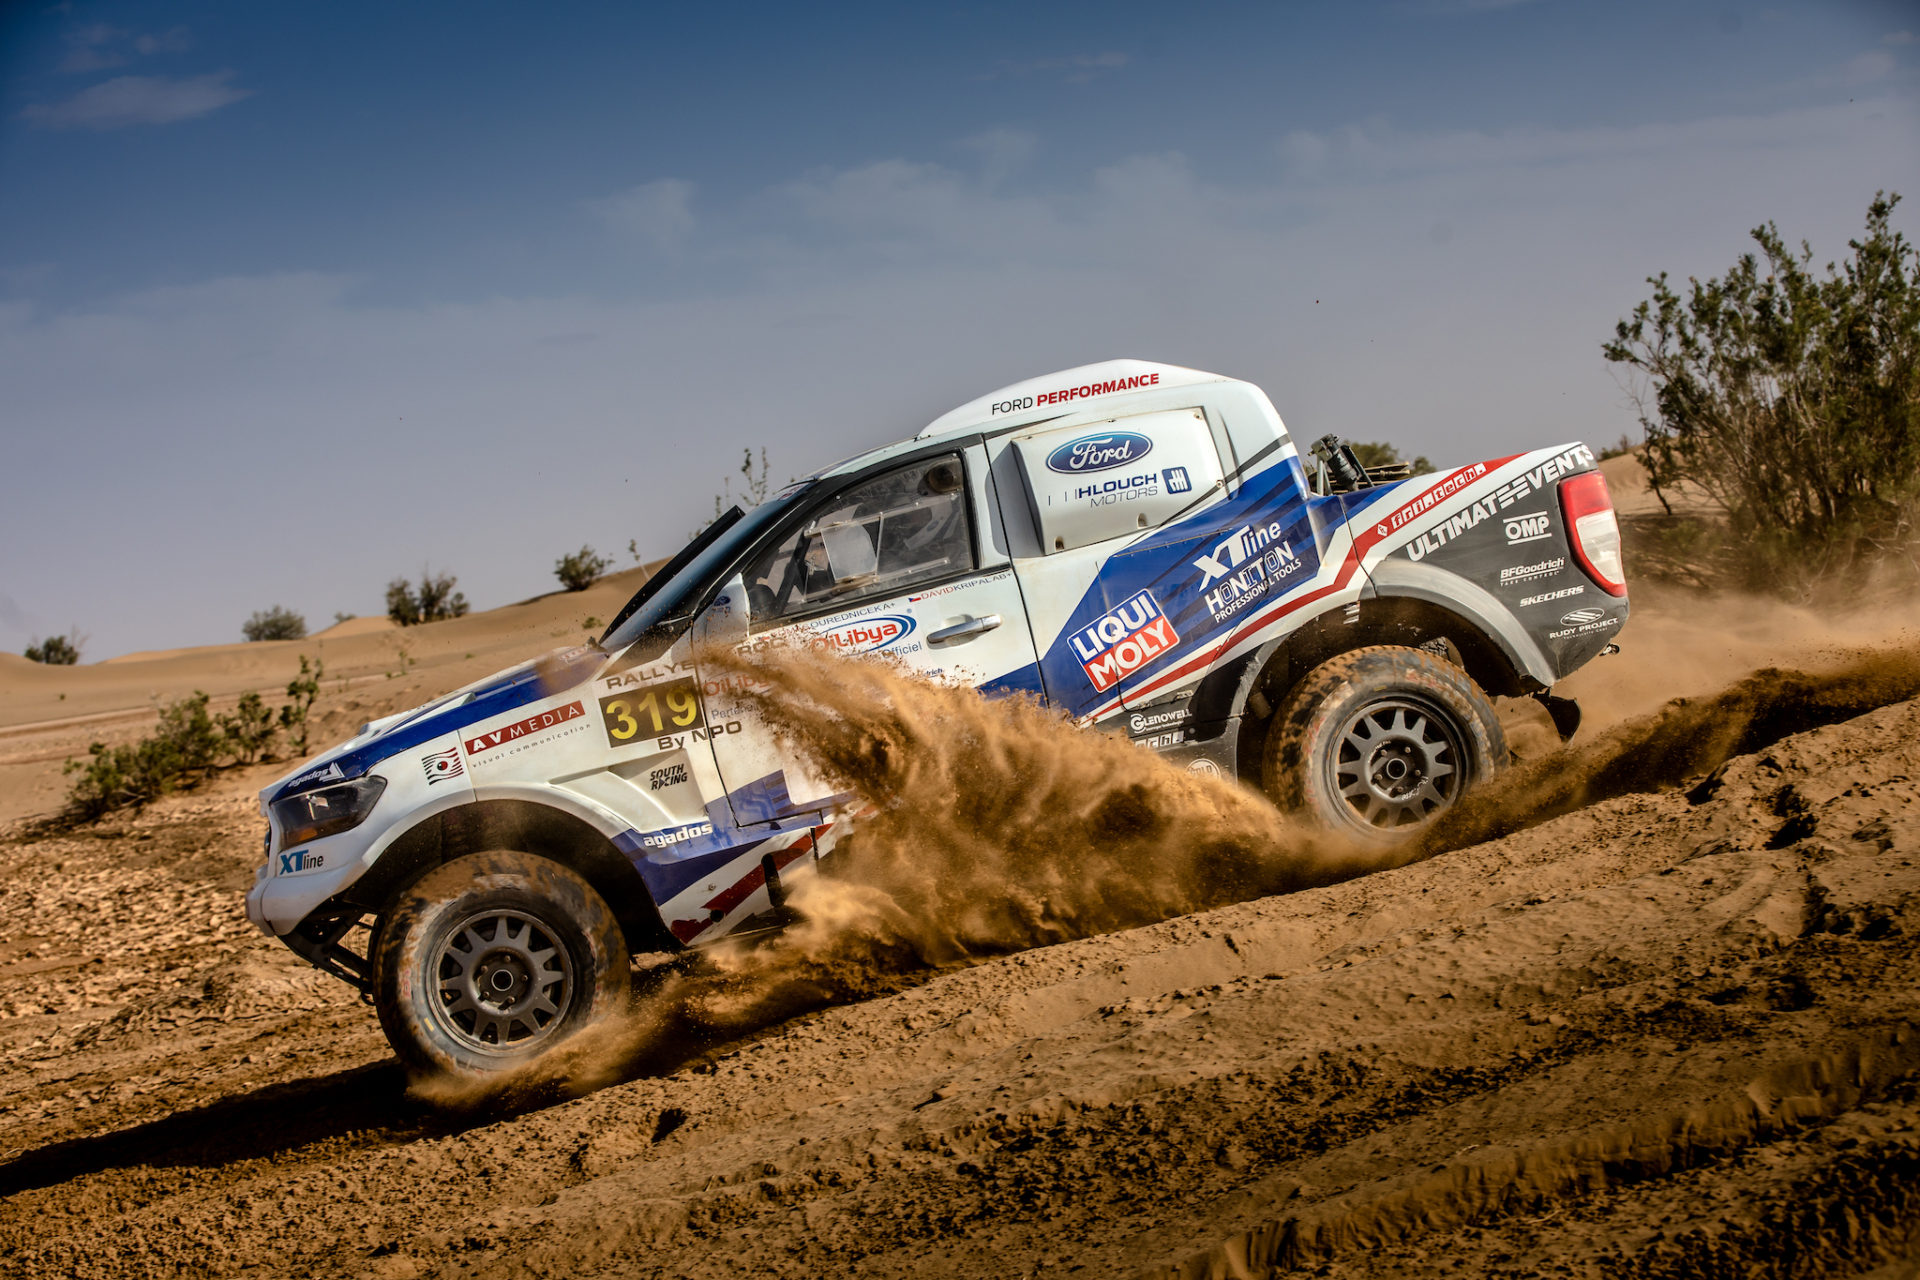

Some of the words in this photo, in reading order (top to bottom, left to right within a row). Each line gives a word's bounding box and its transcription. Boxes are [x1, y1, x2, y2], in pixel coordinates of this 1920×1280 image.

[992, 397, 1033, 415] FORD
[1037, 373, 1159, 406] PERFORMANCE
[1069, 437, 1133, 469] Ford
[1078, 473, 1158, 499] HLOUCH
[1090, 486, 1158, 508] MOTORS
[1505, 516, 1550, 540] OMP
[1204, 540, 1295, 615] HONITON
[1500, 557, 1565, 579] BFGoodrich
[1214, 578, 1275, 624] PROFESSIONAL
[1274, 558, 1302, 581] TOOLS
[1520, 585, 1585, 608] SKECHERS
[1072, 594, 1158, 662] LIQUI
[1549, 627, 1577, 639] RUDY
[1579, 617, 1619, 632] PROJECT
[882, 641, 923, 659] Officiel
[1089, 617, 1173, 687] MOLY
[606, 661, 695, 689] RALLYE
[606, 686, 698, 740] 319
[473, 752, 505, 768] visual
[509, 723, 591, 755] communication
[658, 736, 685, 750] By
[692, 720, 743, 744] NPO
[650, 763, 685, 782] SOUTH
[643, 823, 713, 849] agados
[280, 849, 324, 876] XTline
